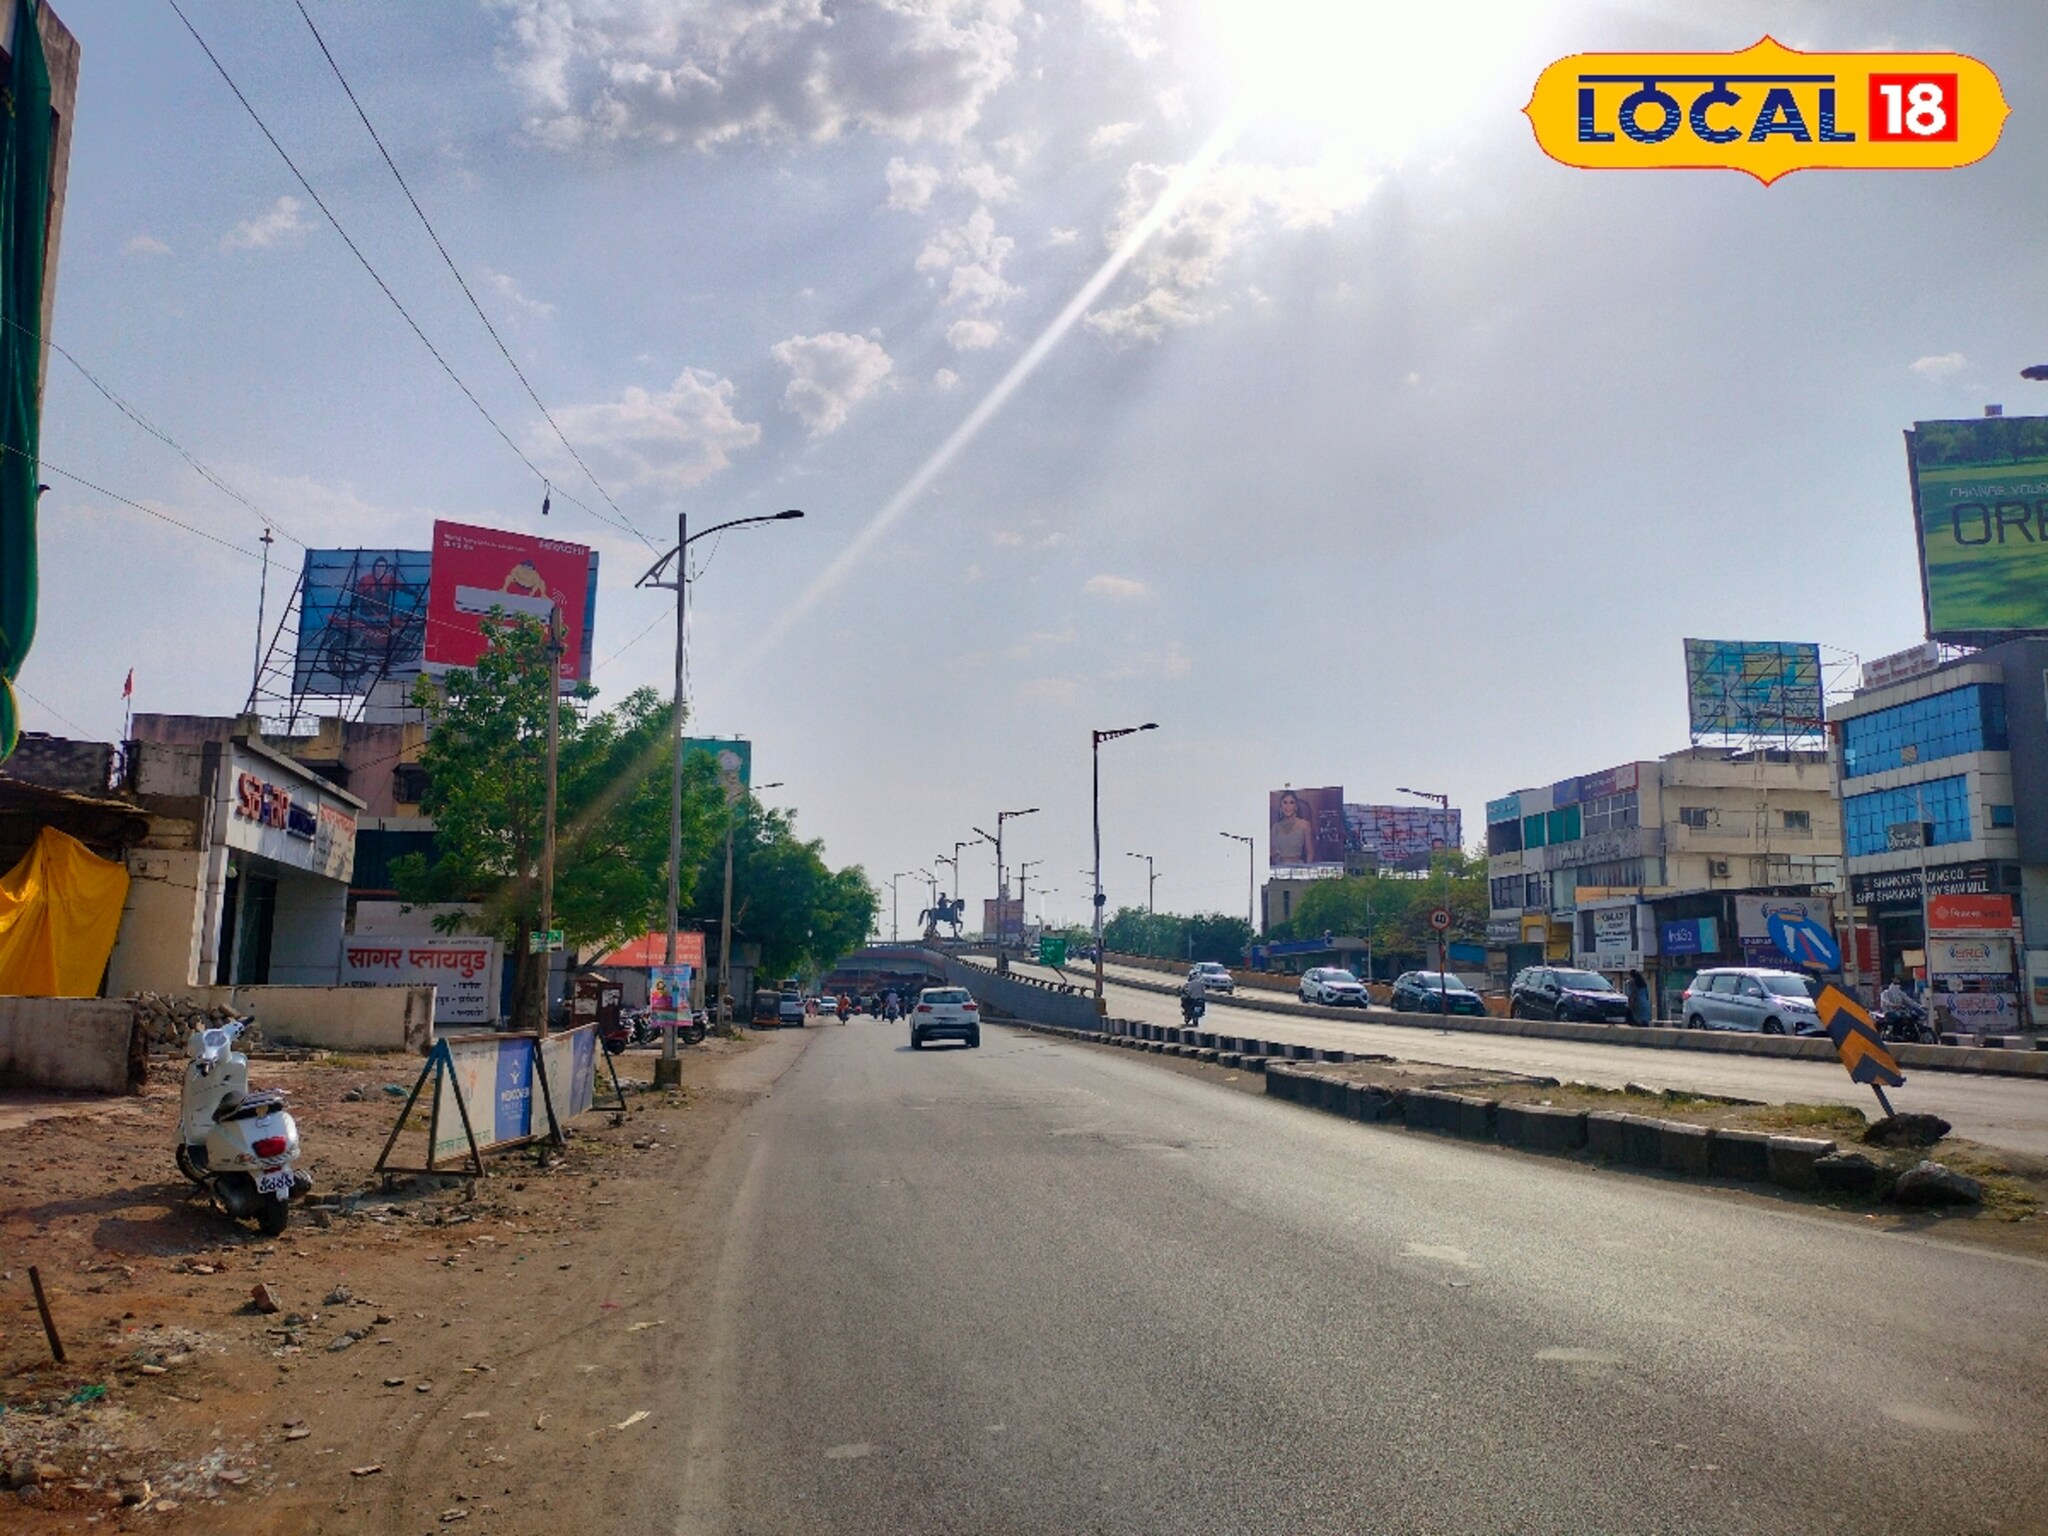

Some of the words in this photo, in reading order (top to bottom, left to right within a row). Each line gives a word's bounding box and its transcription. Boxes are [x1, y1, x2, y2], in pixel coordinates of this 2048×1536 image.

[1950, 485, 2005, 498] CHANGE
[1434, 913, 1446, 924] 40
[347, 949, 403, 969] सागर
[409, 949, 487, 978] प्लायवुड
